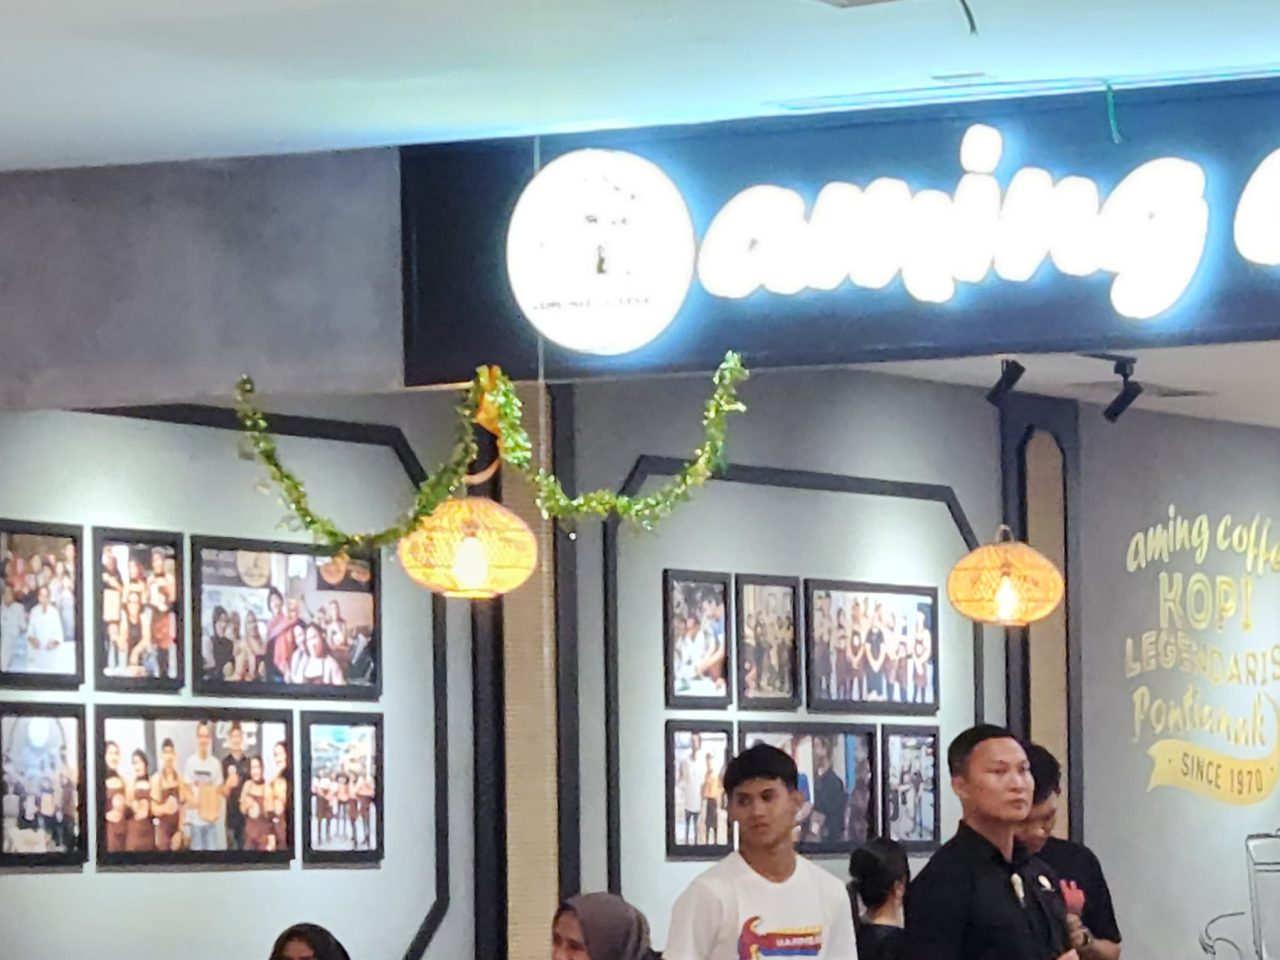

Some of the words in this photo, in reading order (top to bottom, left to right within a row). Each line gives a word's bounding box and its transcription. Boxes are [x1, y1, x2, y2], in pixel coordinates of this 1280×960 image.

[696, 123, 1208, 320] aming
[1126, 503, 1210, 572] aming
[1158, 571, 1254, 632] KOPI
[1180, 752, 1222, 790] SINCE
[1230, 769, 1263, 795] 1970
